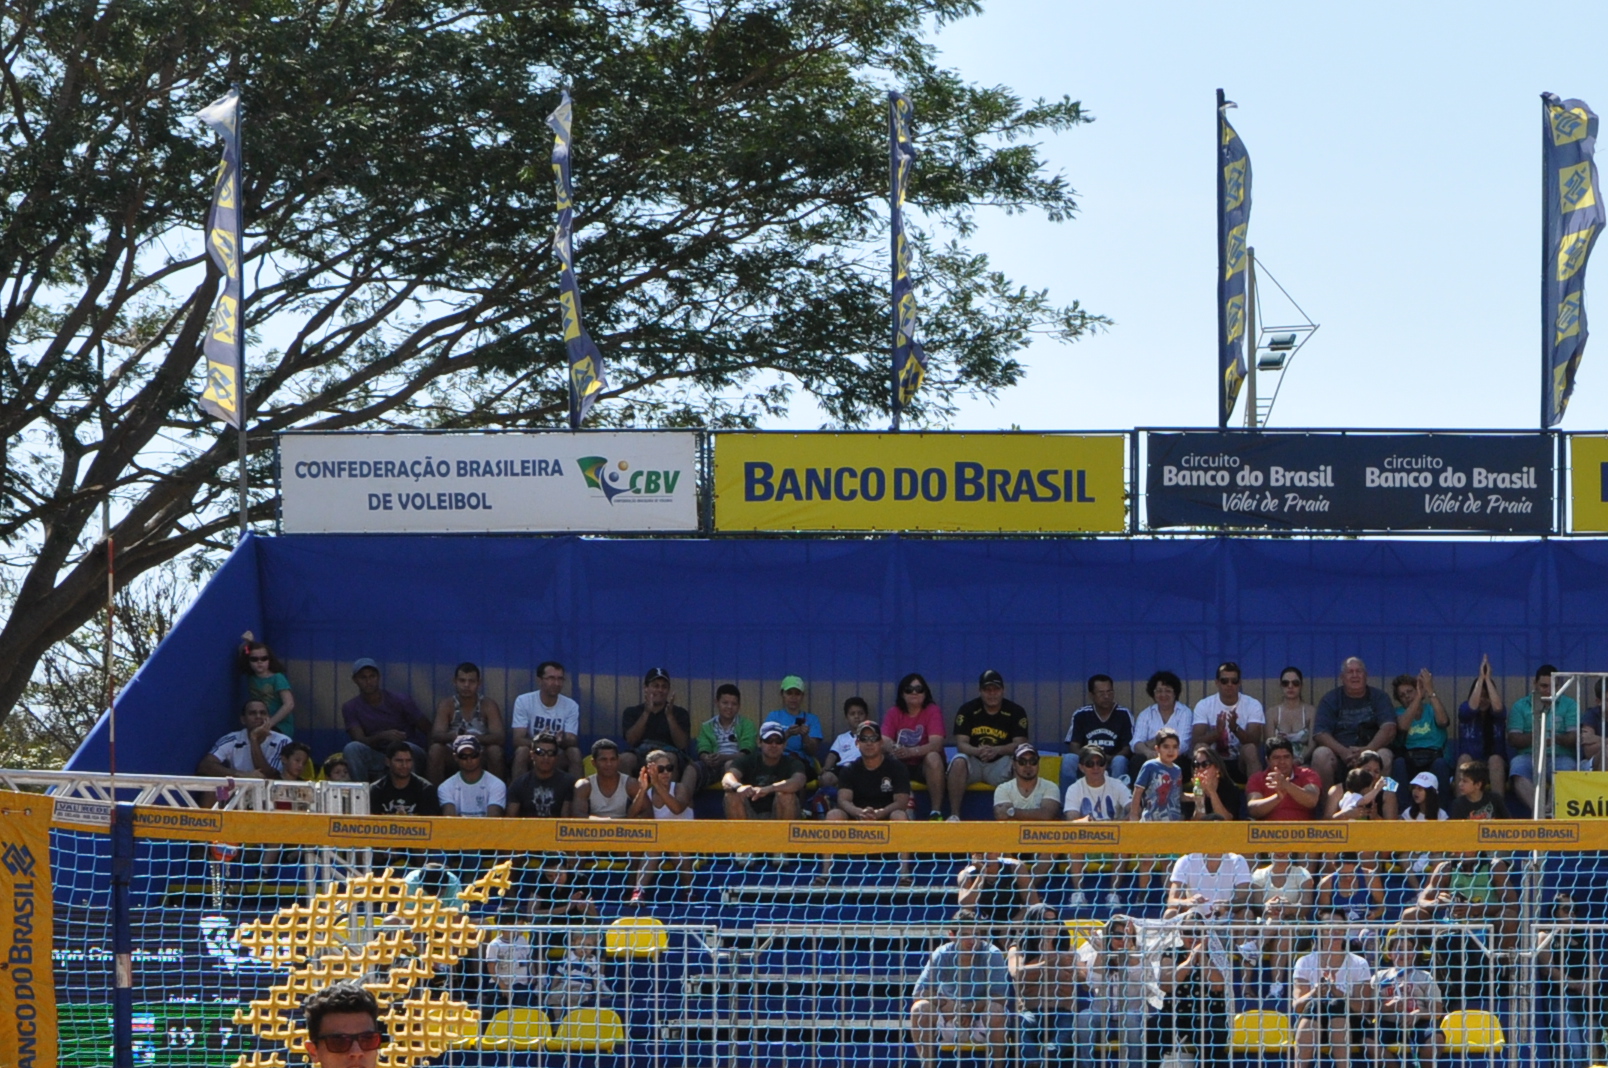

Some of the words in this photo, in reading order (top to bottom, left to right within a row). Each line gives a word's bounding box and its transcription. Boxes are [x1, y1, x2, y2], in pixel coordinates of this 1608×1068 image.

[295, 454, 450, 482] CONFEDERAÇÃO
[457, 457, 564, 479] BRASILEIRA
[1181, 452, 1240, 468] circuito
[1384, 454, 1443, 470] circuito
[629, 470, 681, 494] CBV
[744, 461, 885, 502] BANCO
[893, 467, 947, 501] DO
[955, 461, 1096, 503] BRASIL
[1163, 466, 1229, 487] Banco
[1236, 465, 1263, 487] do
[1270, 464, 1335, 488] Brasil
[1365, 467, 1432, 488] Banco
[1438, 467, 1466, 489] do
[1472, 466, 1537, 489] Brasil
[368, 492, 392, 511] DE
[397, 492, 492, 511] VOLEIBOL
[1221, 492, 1258, 512] Vôlei
[1260, 492, 1279, 513] de
[1284, 492, 1330, 513] Praia
[1424, 493, 1461, 514] Vôlei
[1462, 493, 1482, 514] de
[1487, 494, 1532, 514] Praia
[131, 814, 162, 825] ANCO
[162, 816, 180, 827] DO
[181, 814, 219, 830] BRASIL
[331, 822, 371, 837] BANCO
[372, 825, 388, 838] DO
[388, 823, 428, 838] BRASIL
[560, 826, 599, 841] BANCO
[600, 829, 616, 841] DO
[616, 826, 655, 841] BRASIL
[791, 827, 831, 842] BANCO
[831, 830, 847, 842] DO
[847, 827, 887, 842] BRASIL
[1022, 828, 1062, 843] BANCO
[1062, 831, 1078, 843] DO
[1078, 828, 1118, 843] BRASIL
[1250, 826, 1289, 842] BANCO
[1290, 829, 1306, 842] DO
[1306, 826, 1345, 842] BRASIL
[1481, 827, 1520, 841] BANCO
[1521, 830, 1537, 841] DO
[1537, 827, 1576, 841] BRASIL
[9, 880, 34, 966] BRASIL
[11, 966, 33, 1002] DO
